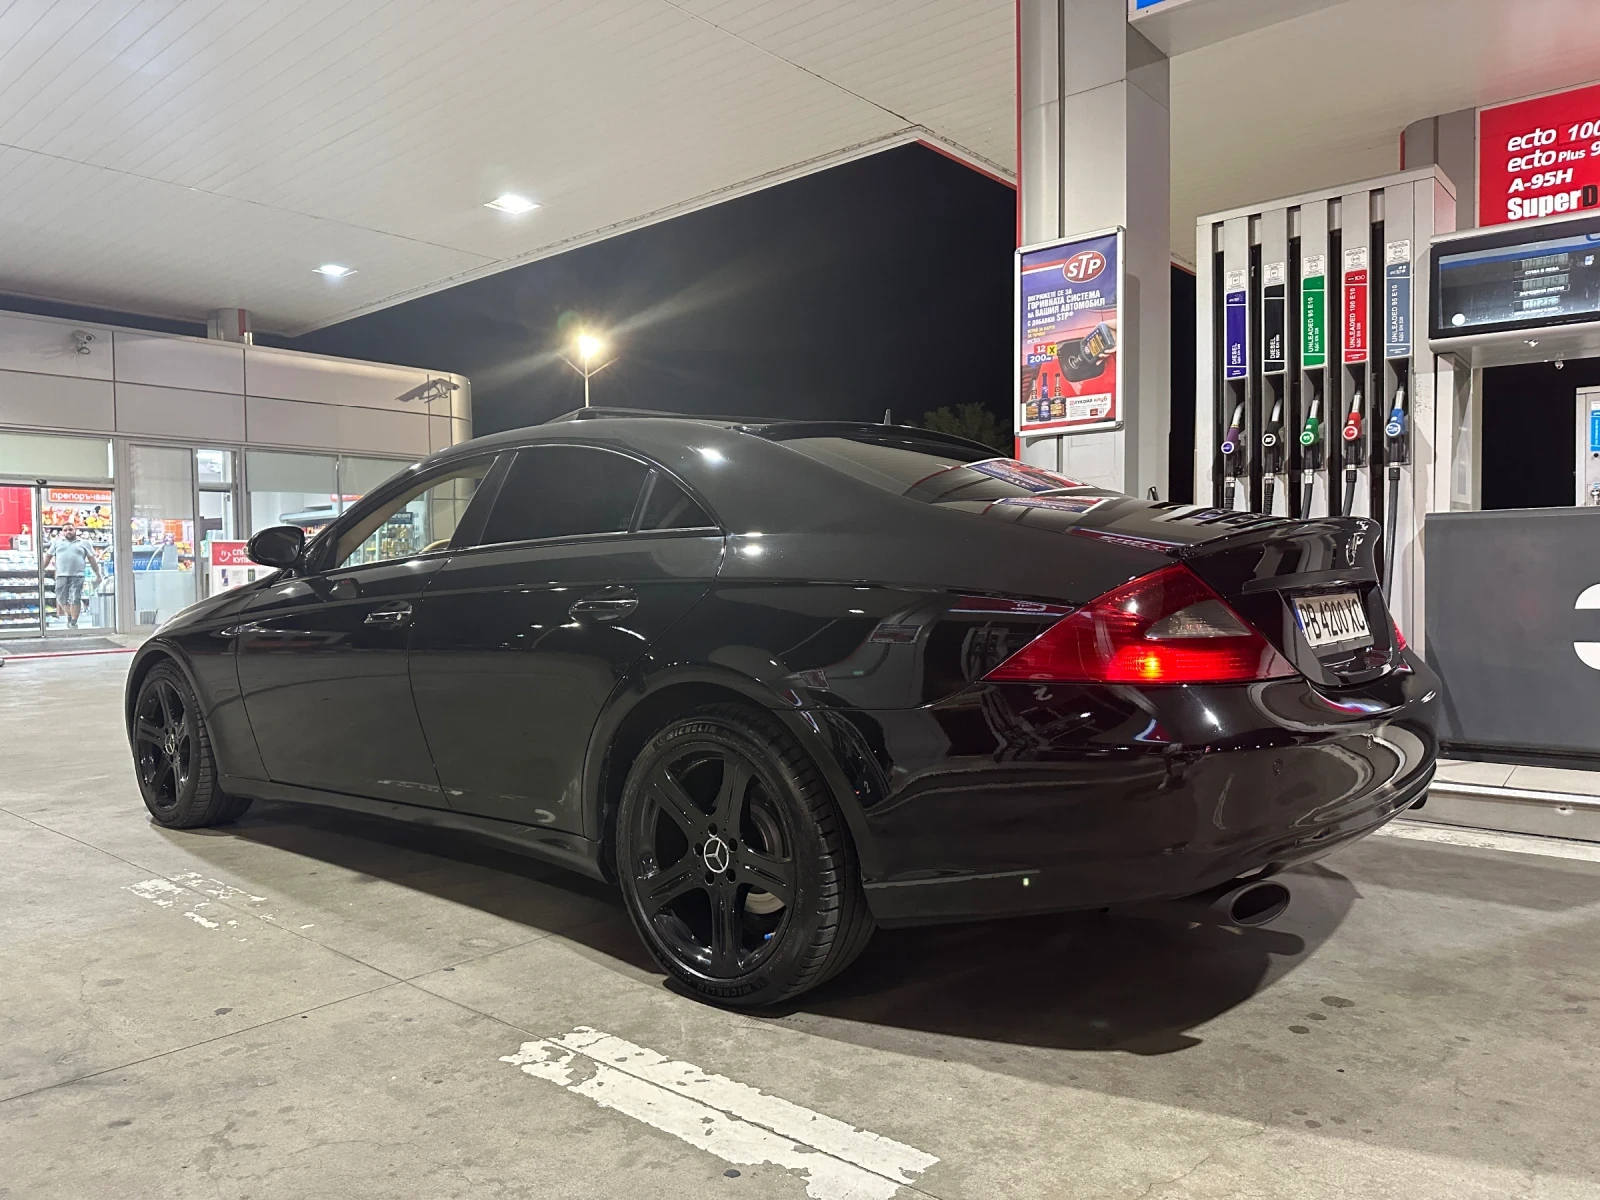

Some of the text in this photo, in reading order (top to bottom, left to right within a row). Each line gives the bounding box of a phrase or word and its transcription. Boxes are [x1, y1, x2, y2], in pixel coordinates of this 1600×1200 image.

[1507, 128, 1557, 151] ecto
[1507, 149, 1557, 172] ecto
[1558, 150, 1586, 162] Plus
[1067, 253, 1101, 278] STP
[1027, 290, 1100, 310] ГОРИВНАТА СИСТЕМА
[1035, 306, 1059, 317] ВАШИЯ
[1060, 298, 1105, 312] АВТОМОБИЛ
[1392, 296, 1398, 305] 95
[1036, 345, 1046, 353] 12
[1298, 598, 1366, 641] PB 4200 XC
[666, 724, 718, 741] MICHELIN
